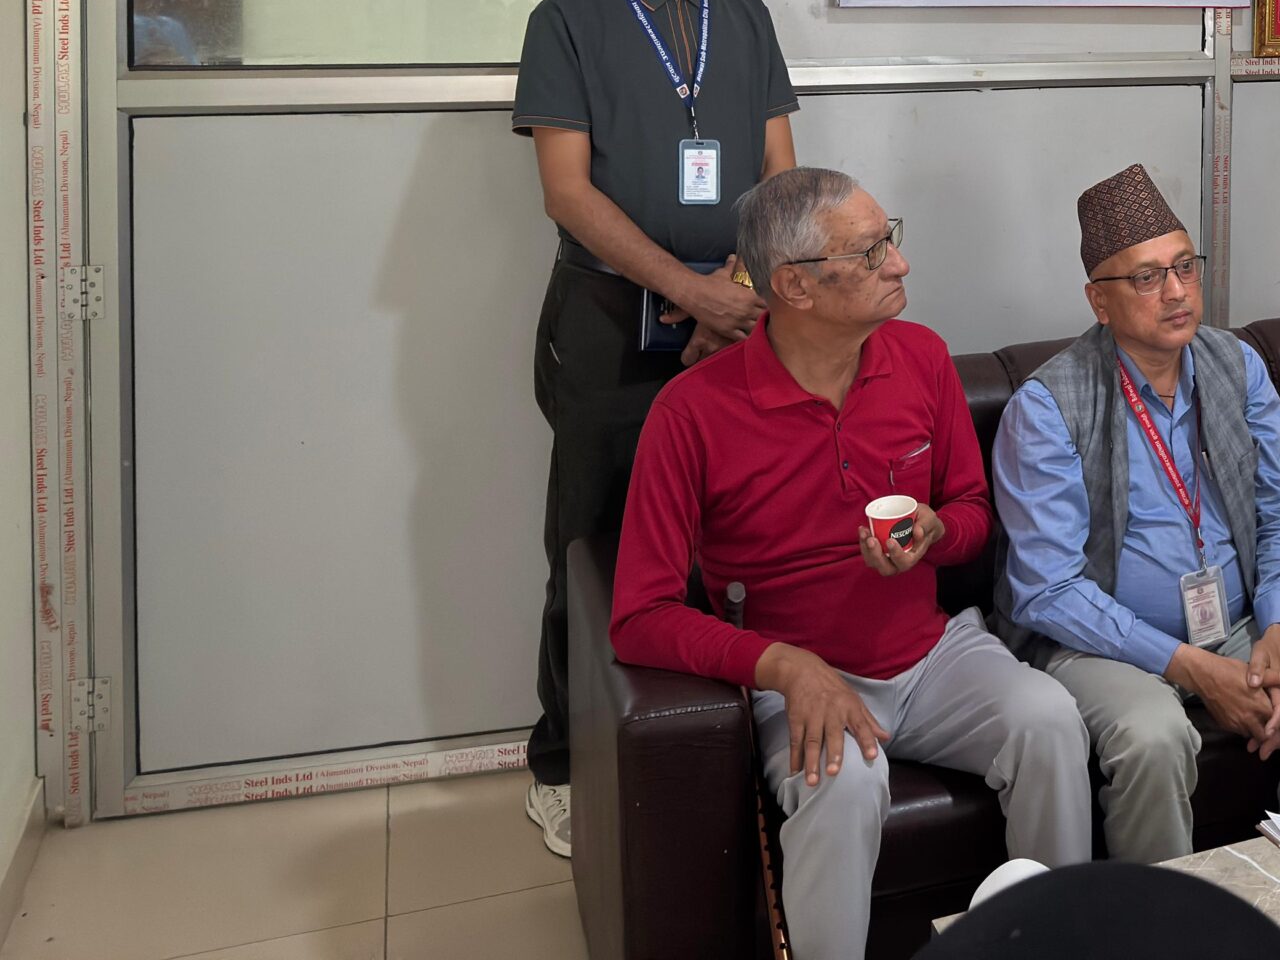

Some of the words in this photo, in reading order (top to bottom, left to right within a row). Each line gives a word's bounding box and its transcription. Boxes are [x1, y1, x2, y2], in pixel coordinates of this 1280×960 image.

[58, 14, 69, 35] Inds
[58, 38, 69, 60] Steel
[33, 200, 44, 222] Steel
[33, 225, 45, 249] Inds
[34, 250, 45, 265] Ltd
[60, 242, 71, 259] Ltd
[64, 506, 75, 527] Inds
[64, 530, 75, 553] Steel
[497, 745, 520, 756] Steel
[244, 778, 268, 789] Steel
[271, 774, 292, 785] Inds
[295, 771, 313, 782] Ltd
[244, 790, 268, 801] Steel
